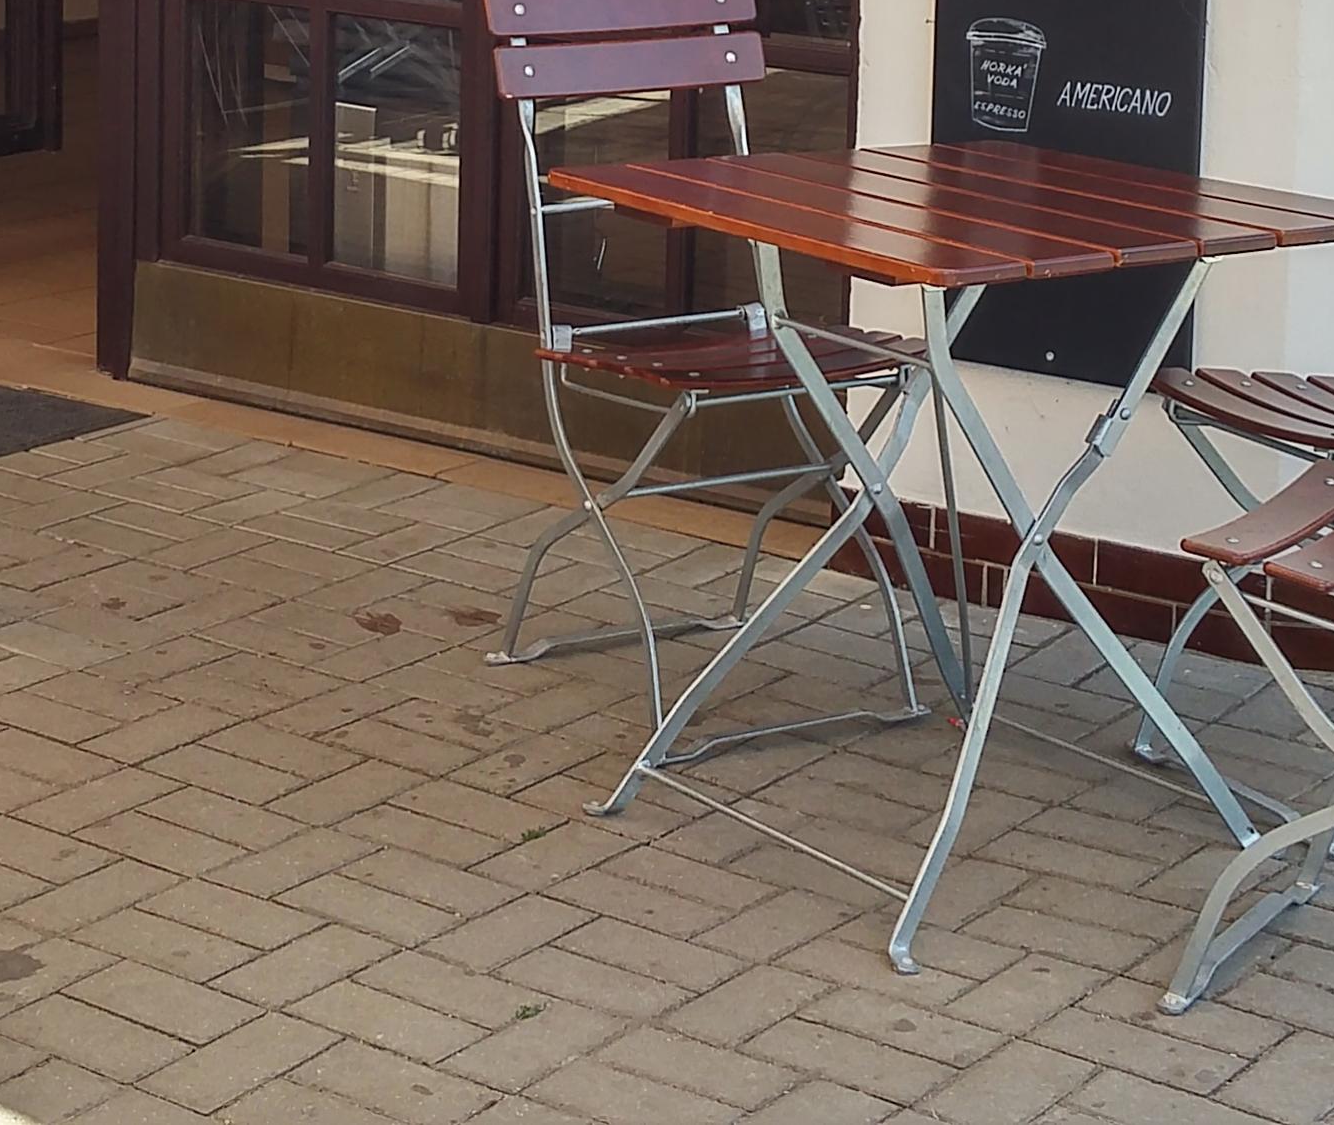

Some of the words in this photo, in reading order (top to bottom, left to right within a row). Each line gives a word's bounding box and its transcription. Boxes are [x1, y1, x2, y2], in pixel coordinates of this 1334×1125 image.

[980, 59, 1028, 78] HORKÁ
[987, 73, 1017, 89] VODA
[1057, 80, 1172, 117] AMERICANO
[974, 101, 1026, 119] ESPRESSO
